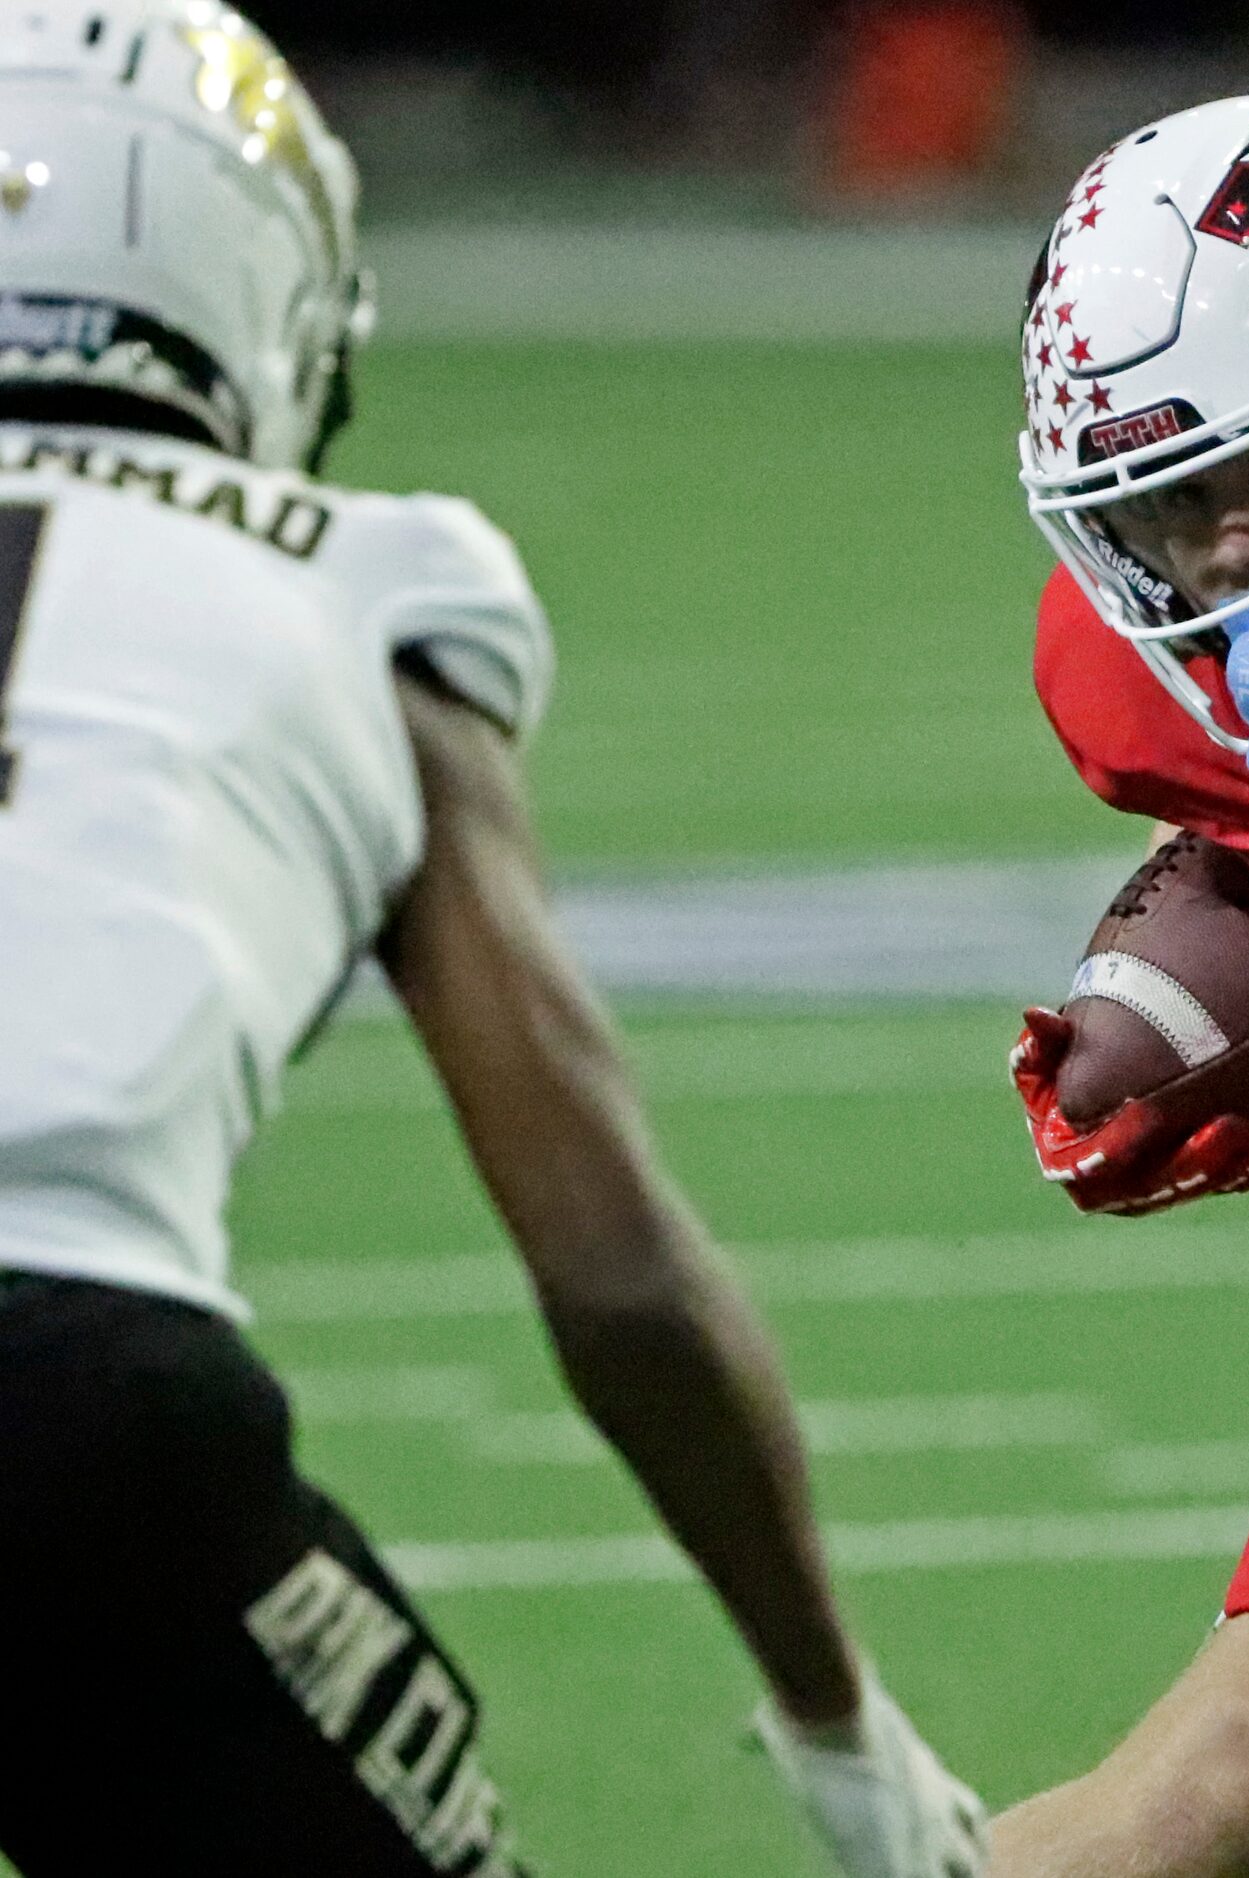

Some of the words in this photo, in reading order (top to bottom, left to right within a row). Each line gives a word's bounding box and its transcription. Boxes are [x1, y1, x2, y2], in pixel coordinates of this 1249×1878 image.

[1090, 404, 1182, 458] TTH
[0, 438, 331, 559] MMAD
[1098, 537, 1174, 604] Riddell
